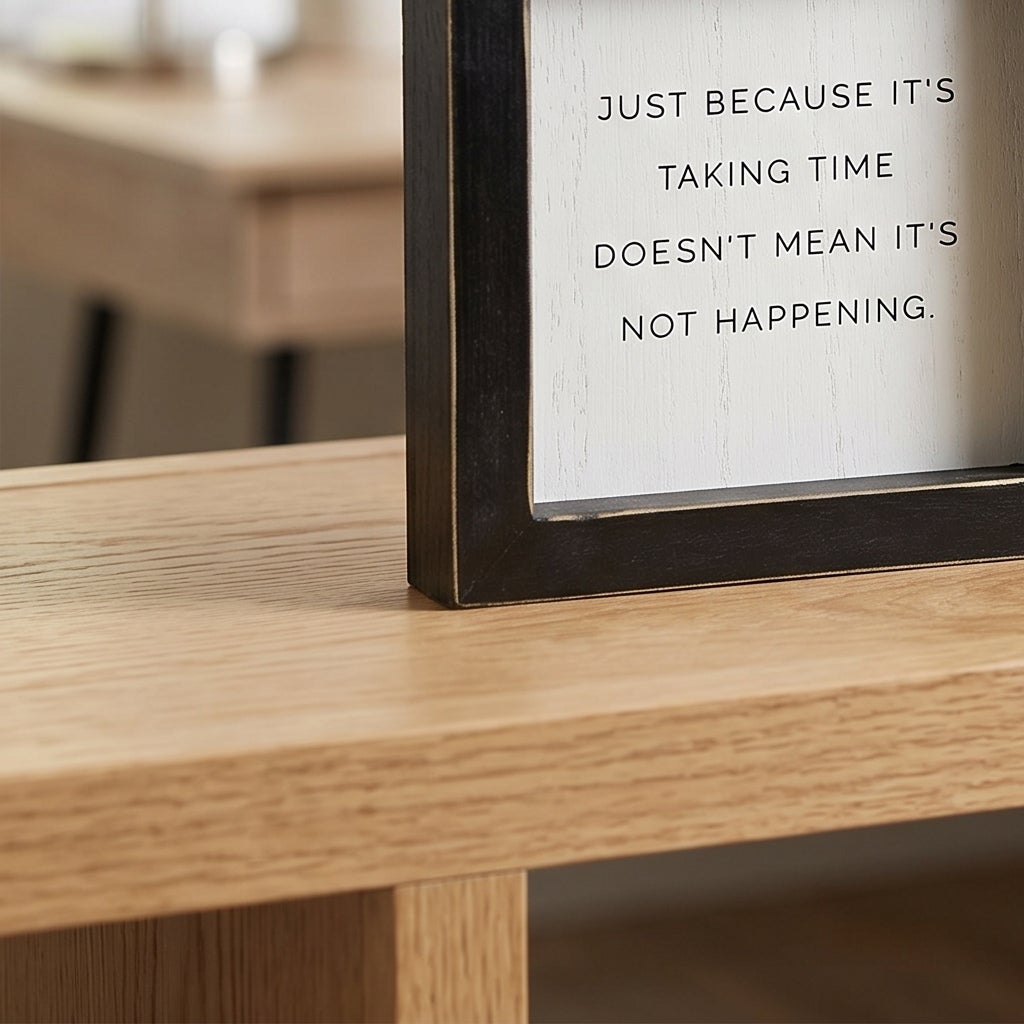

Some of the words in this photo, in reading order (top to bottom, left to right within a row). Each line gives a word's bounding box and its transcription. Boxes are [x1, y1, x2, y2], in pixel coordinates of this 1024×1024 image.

[597, 91, 687, 121] JUST
[706, 81, 873, 116] BECAUSE
[893, 77, 956, 106] IT'S
[657, 158, 790, 191] TAKING
[807, 152, 893, 182] TIME
[594, 233, 757, 269] DOESN'T
[775, 226, 876, 258] MEAN
[896, 221, 958, 250] IT'S
[621, 310, 698, 342] NOT
[716, 295, 936, 335] HAPPENING.
